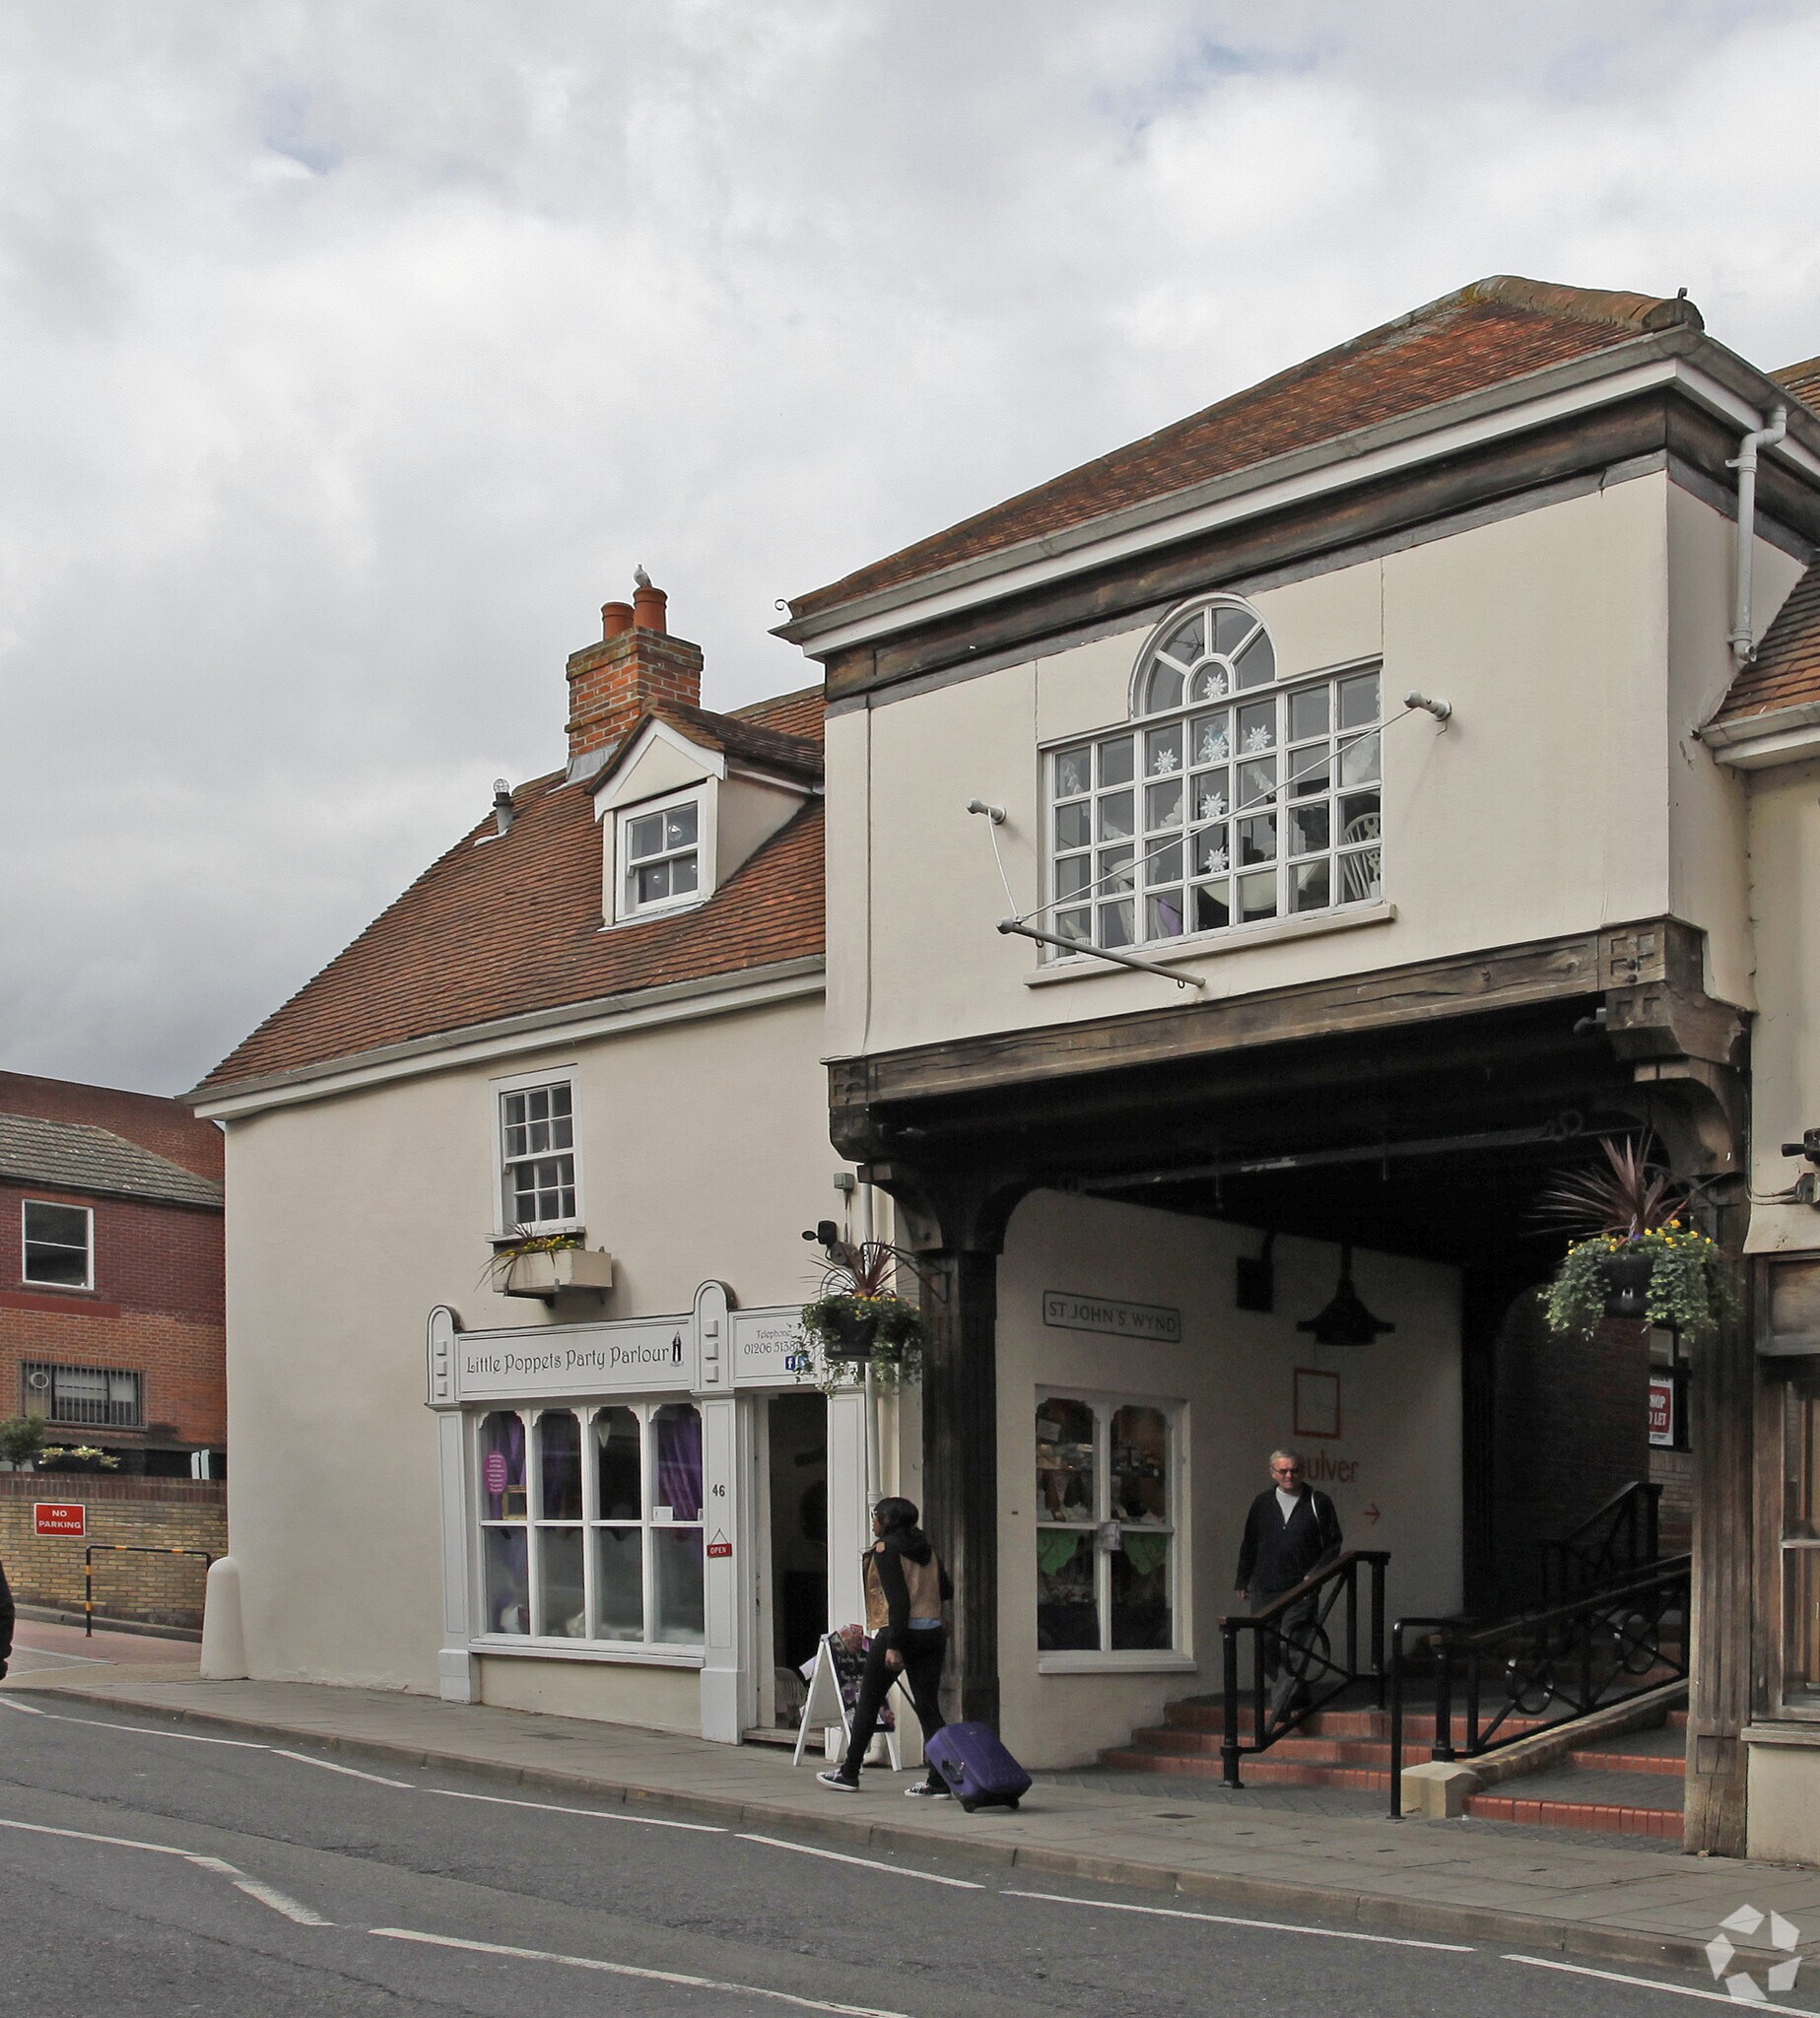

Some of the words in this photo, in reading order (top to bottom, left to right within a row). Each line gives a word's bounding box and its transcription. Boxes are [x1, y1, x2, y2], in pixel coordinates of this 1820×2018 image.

[1131, 1312, 1177, 1333] WYND
[744, 1342, 773, 1355] 01206
[774, 1340, 802, 1353] 5138
[467, 1355, 501, 1375] Little
[504, 1353, 562, 1375] Poppets
[566, 1349, 605, 1372] Party
[610, 1345, 669, 1369] Parlour
[1650, 1394, 1666, 1409] HOP
[1654, 1412, 1667, 1426] LET
[711, 1484, 725, 1497] 46
[38, 1520, 82, 1529] PARKING
[709, 1546, 727, 1555] OPEN
